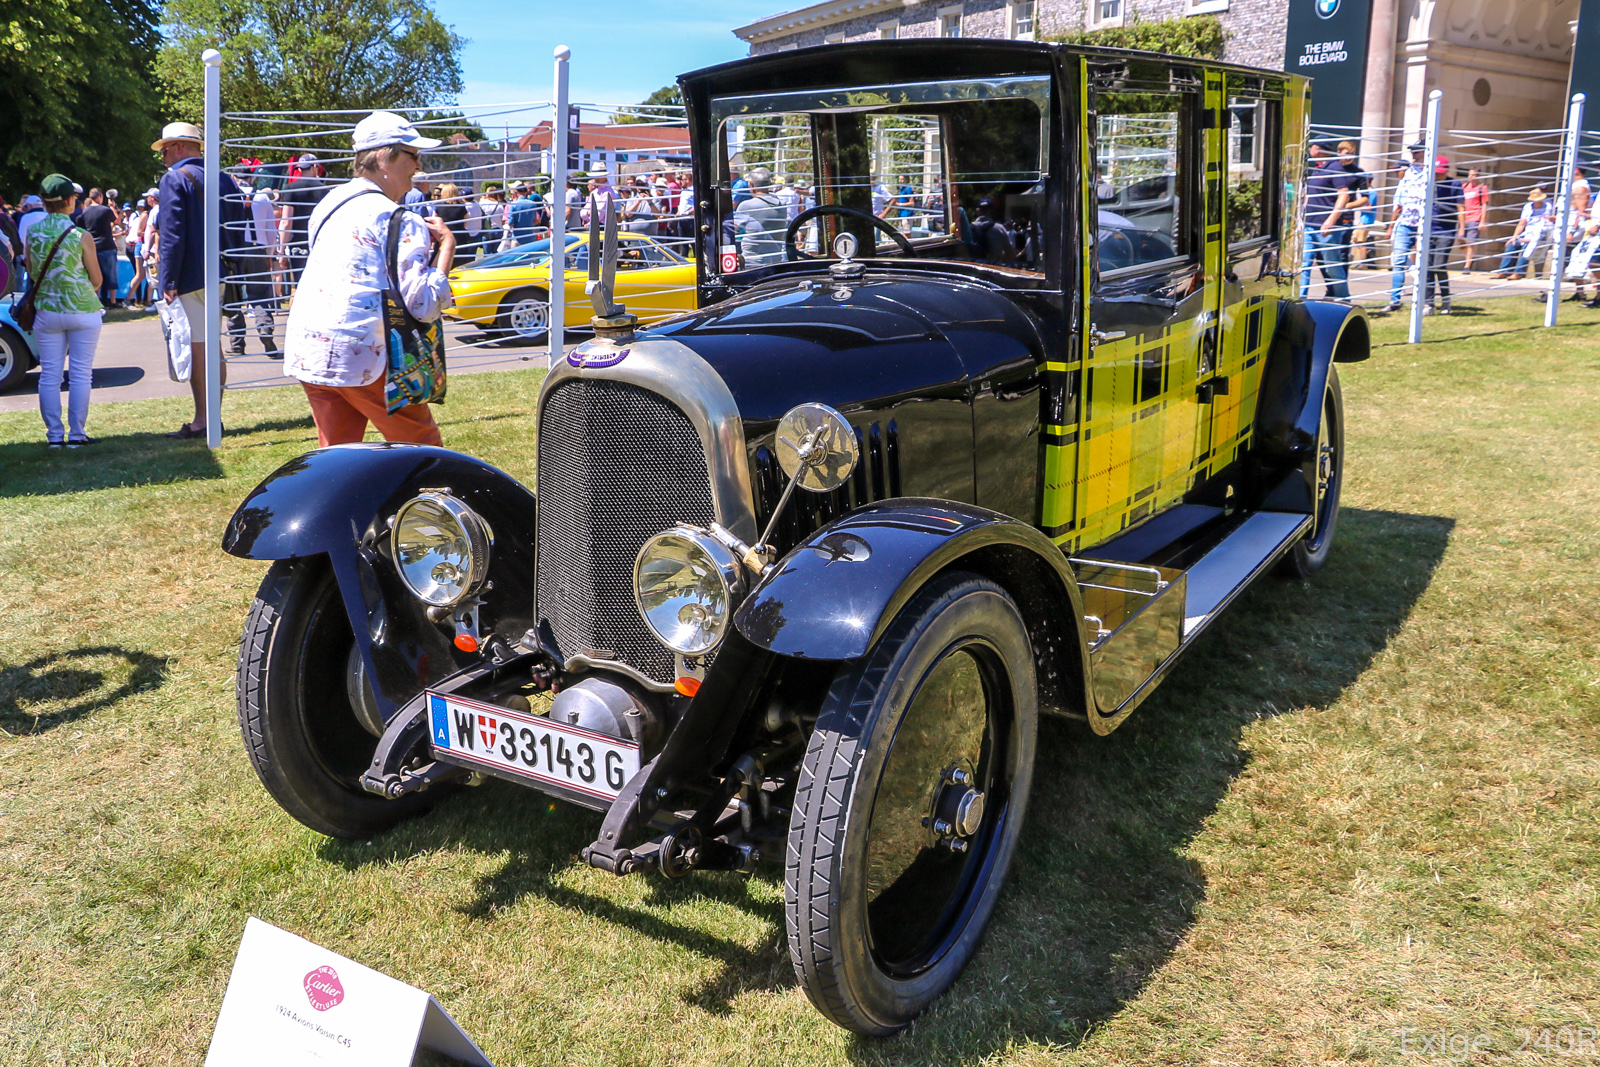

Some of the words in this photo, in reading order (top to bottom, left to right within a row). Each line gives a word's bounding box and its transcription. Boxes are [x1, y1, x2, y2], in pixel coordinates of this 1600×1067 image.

[1304, 43, 1321, 54] THE
[1321, 40, 1345, 53] BMW
[1298, 51, 1348, 66] BOULEVARD
[437, 728, 446, 741] A
[453, 708, 475, 751] W
[500, 722, 596, 783] 33143
[605, 750, 626, 791] G
[306, 973, 342, 997] Cartier
[276, 1004, 292, 1017] 1924
[292, 1012, 314, 1030] Avions
[315, 1023, 336, 1041] Voisin
